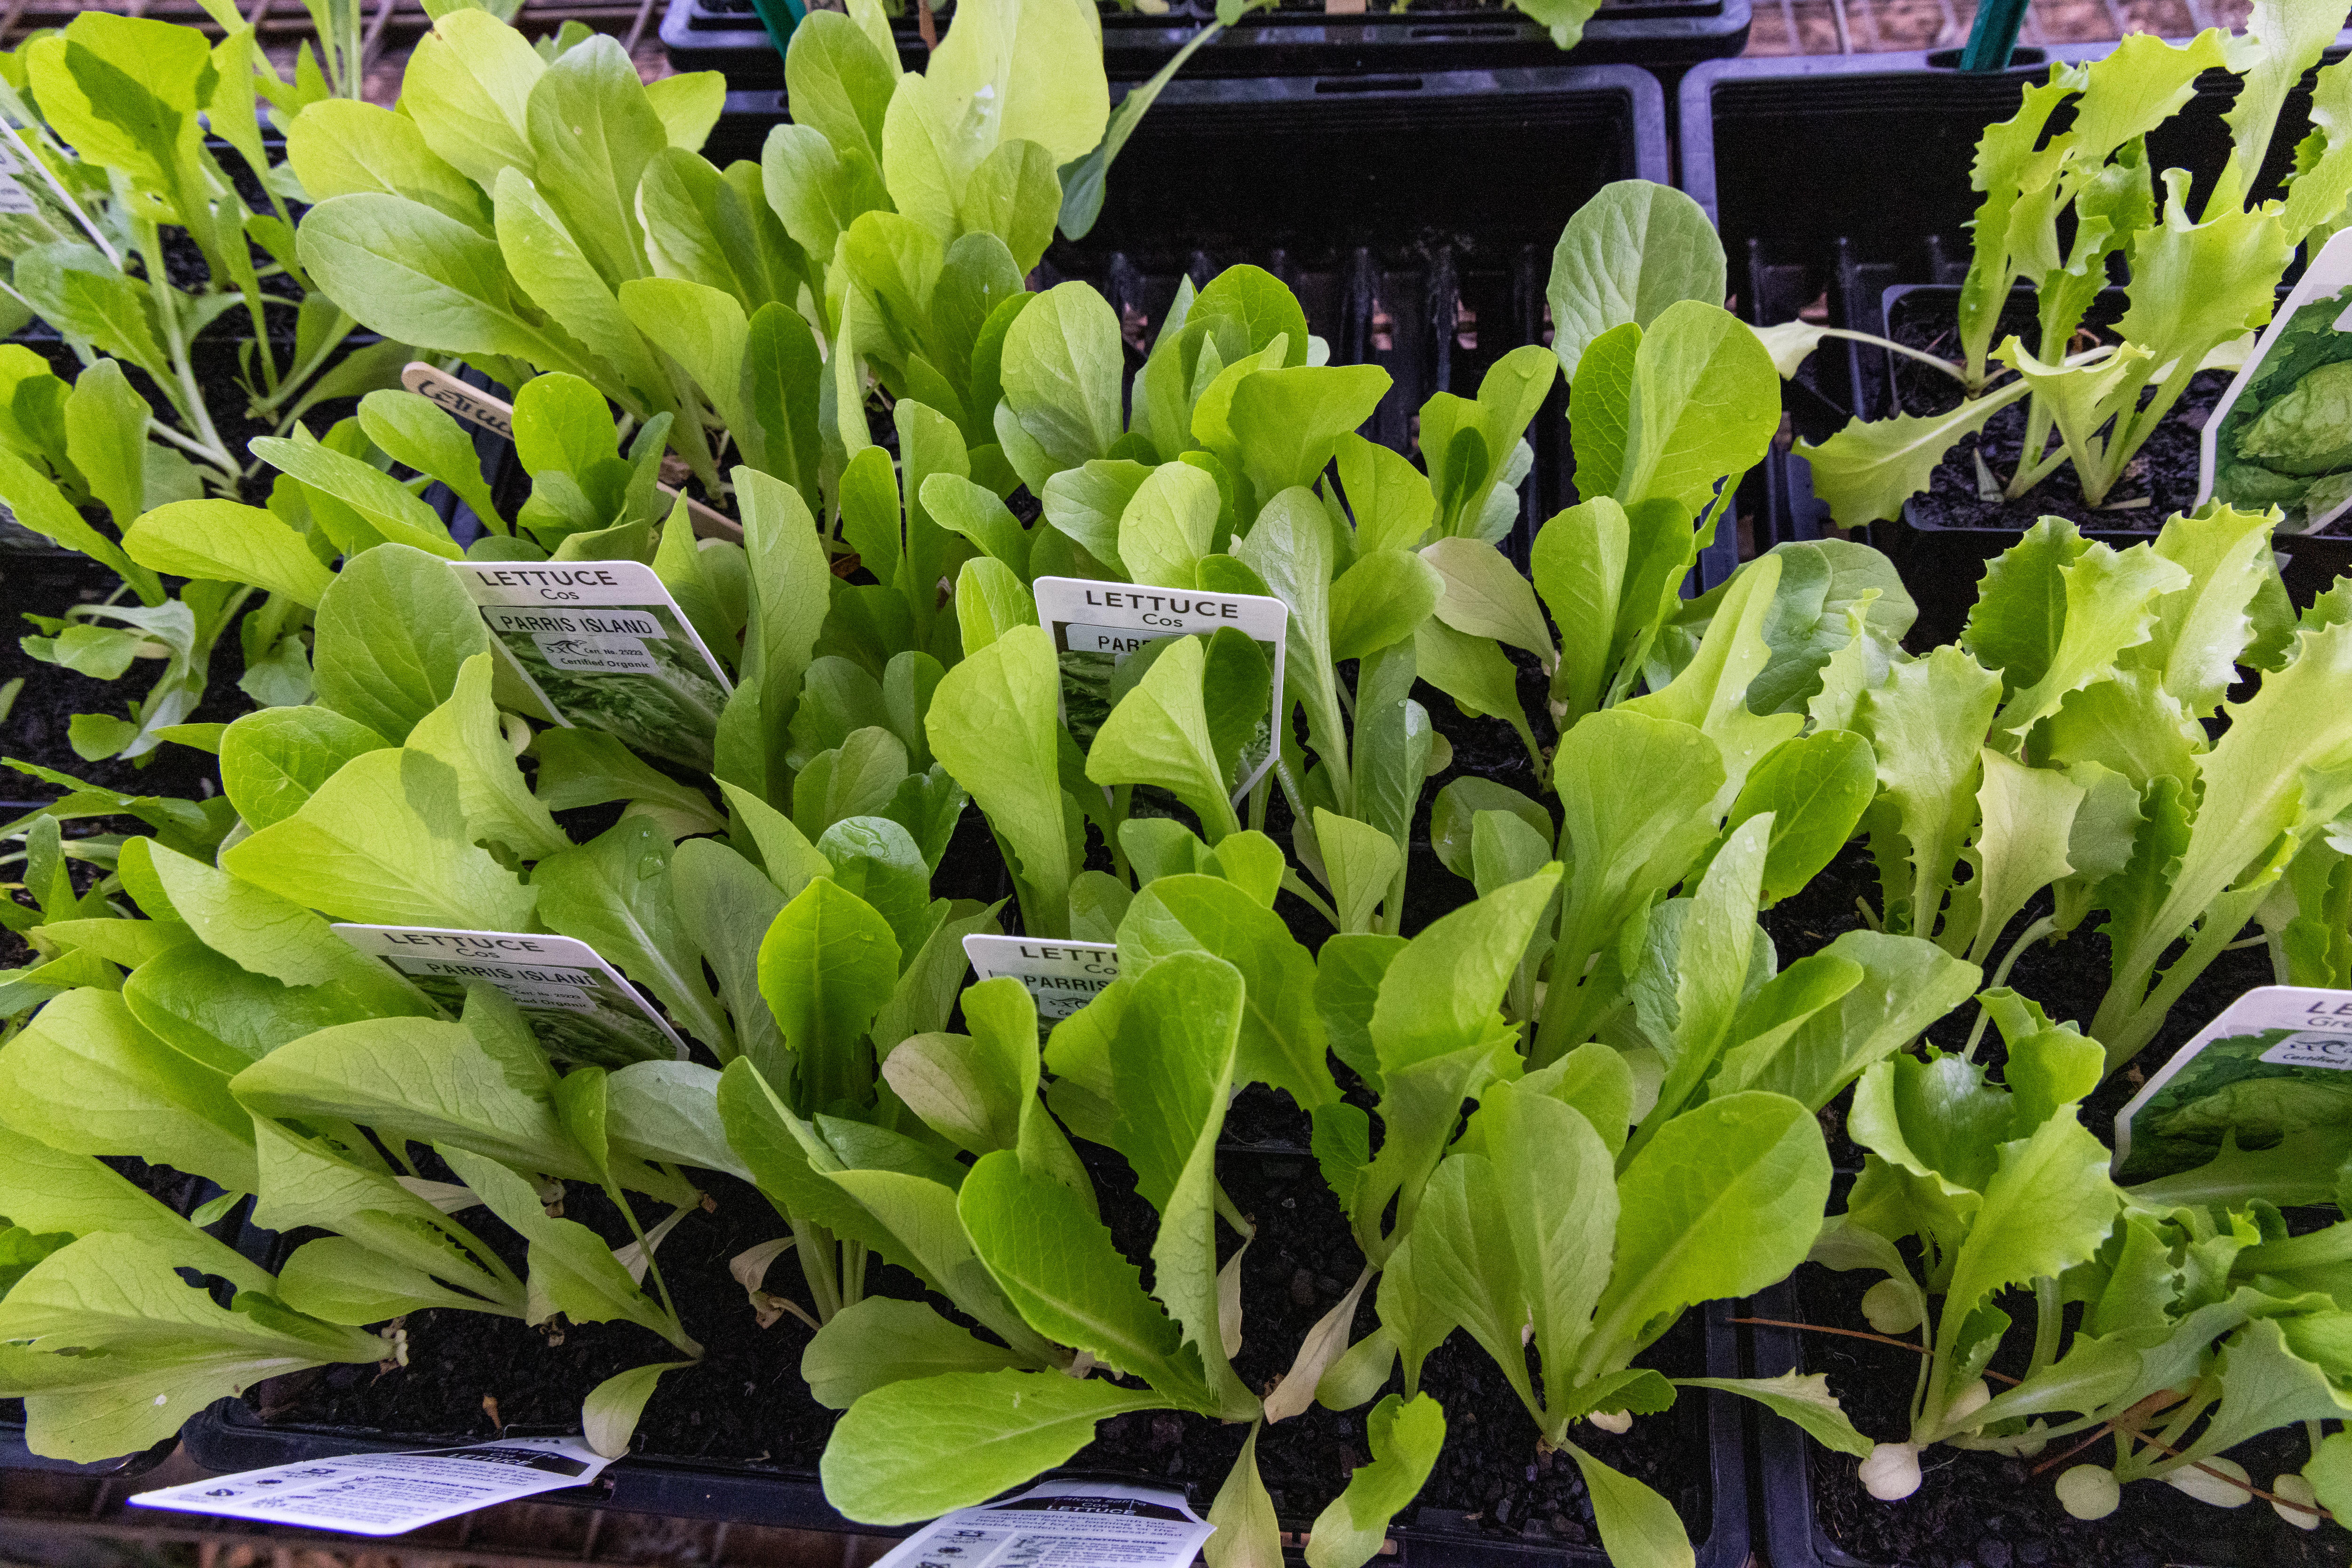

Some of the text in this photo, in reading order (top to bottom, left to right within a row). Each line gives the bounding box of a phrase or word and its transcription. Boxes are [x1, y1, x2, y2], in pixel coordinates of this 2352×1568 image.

[477, 570, 618, 586] LETTUCE
[540, 588, 580, 600] Cos
[1086, 590, 1239, 618] LETTUCE
[500, 616, 653, 634] PARRIS ISLAND
[1142, 613, 1183, 627] Cos
[560, 658, 604, 667] Certified
[382, 933, 544, 952] LETTUCE
[456, 948, 501, 958] Cos
[1020, 945, 1118, 963] LETT
[426, 963, 514, 979] PARRIS
[1084, 964, 1120, 975] Co
[448, 1453, 533, 1466] LETTUCE
[1046, 1505, 1137, 1515] LETTUCE
